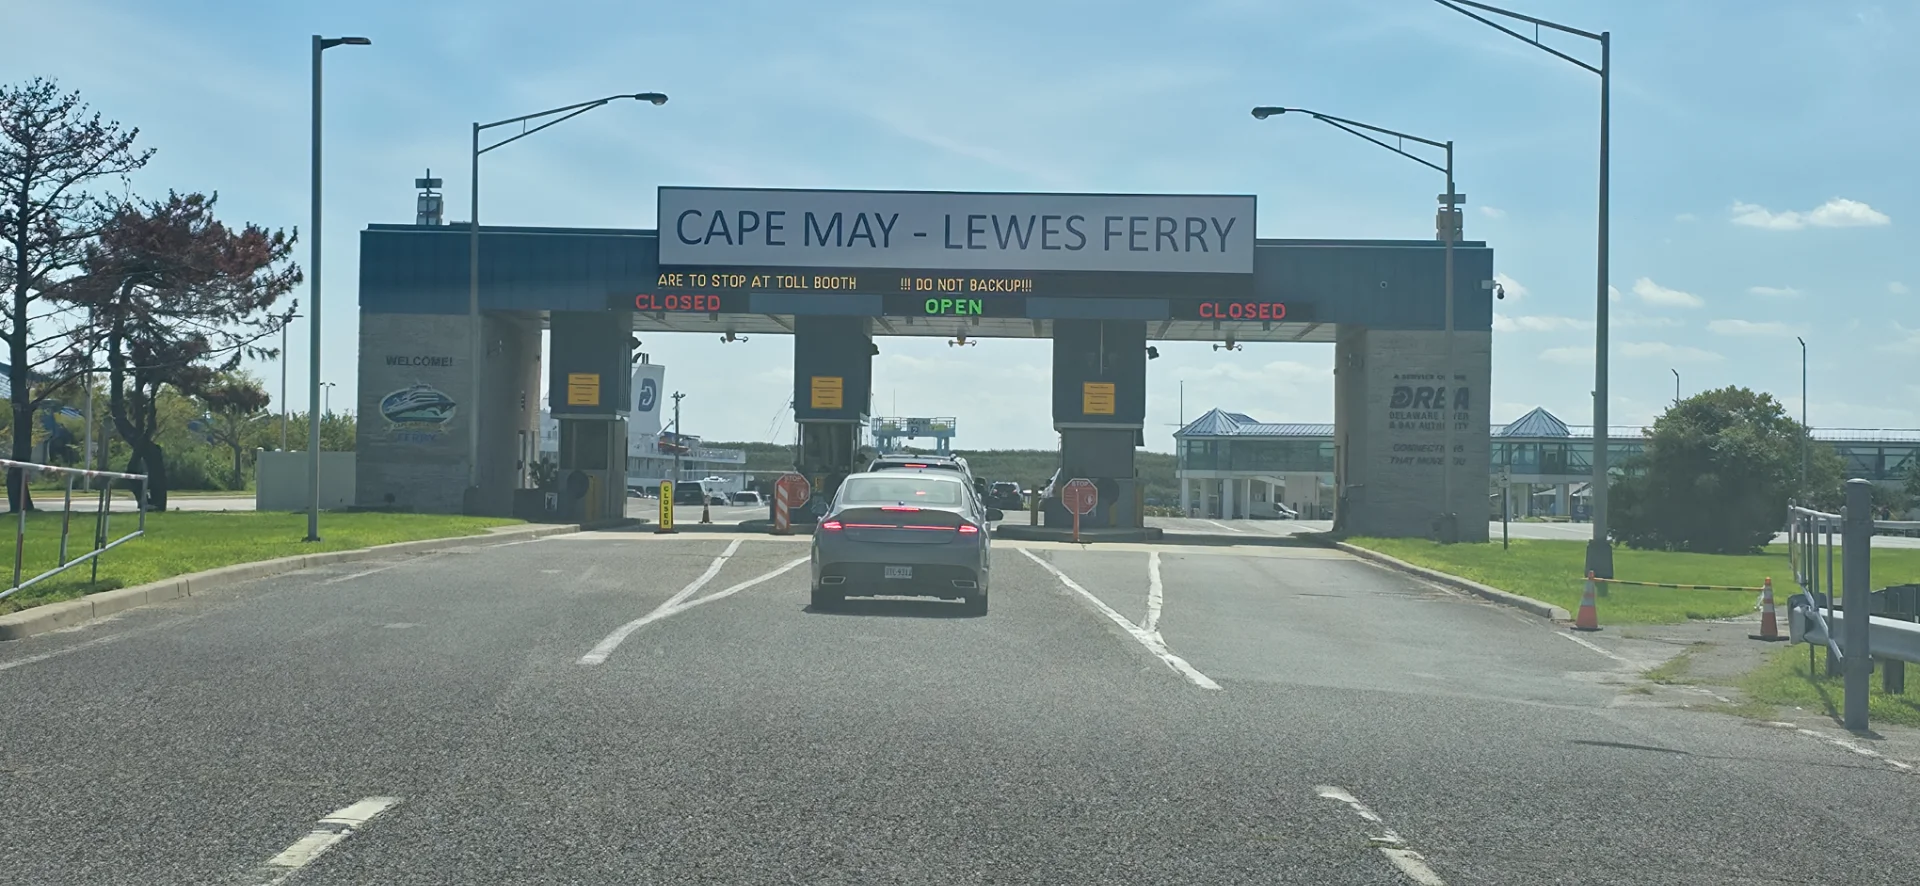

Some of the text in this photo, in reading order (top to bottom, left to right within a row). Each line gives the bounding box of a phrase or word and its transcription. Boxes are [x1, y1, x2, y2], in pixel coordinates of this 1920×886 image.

[677, 209, 786, 246] CAPE
[804, 211, 899, 248] MAY
[944, 213, 1087, 252] LEWES
[1104, 215, 1236, 253] FERRY
[657, 273, 1032, 293] ARE TO STOP AT TOLL BOOTH !!! DO NOT BACKUP!!!
[635, 294, 721, 312] CLOSED
[925, 298, 983, 315] OPEN
[1199, 302, 1286, 319] CLOSED
[385, 355, 453, 367] WELCOME!
[1389, 411, 1439, 420] DELAWARE
